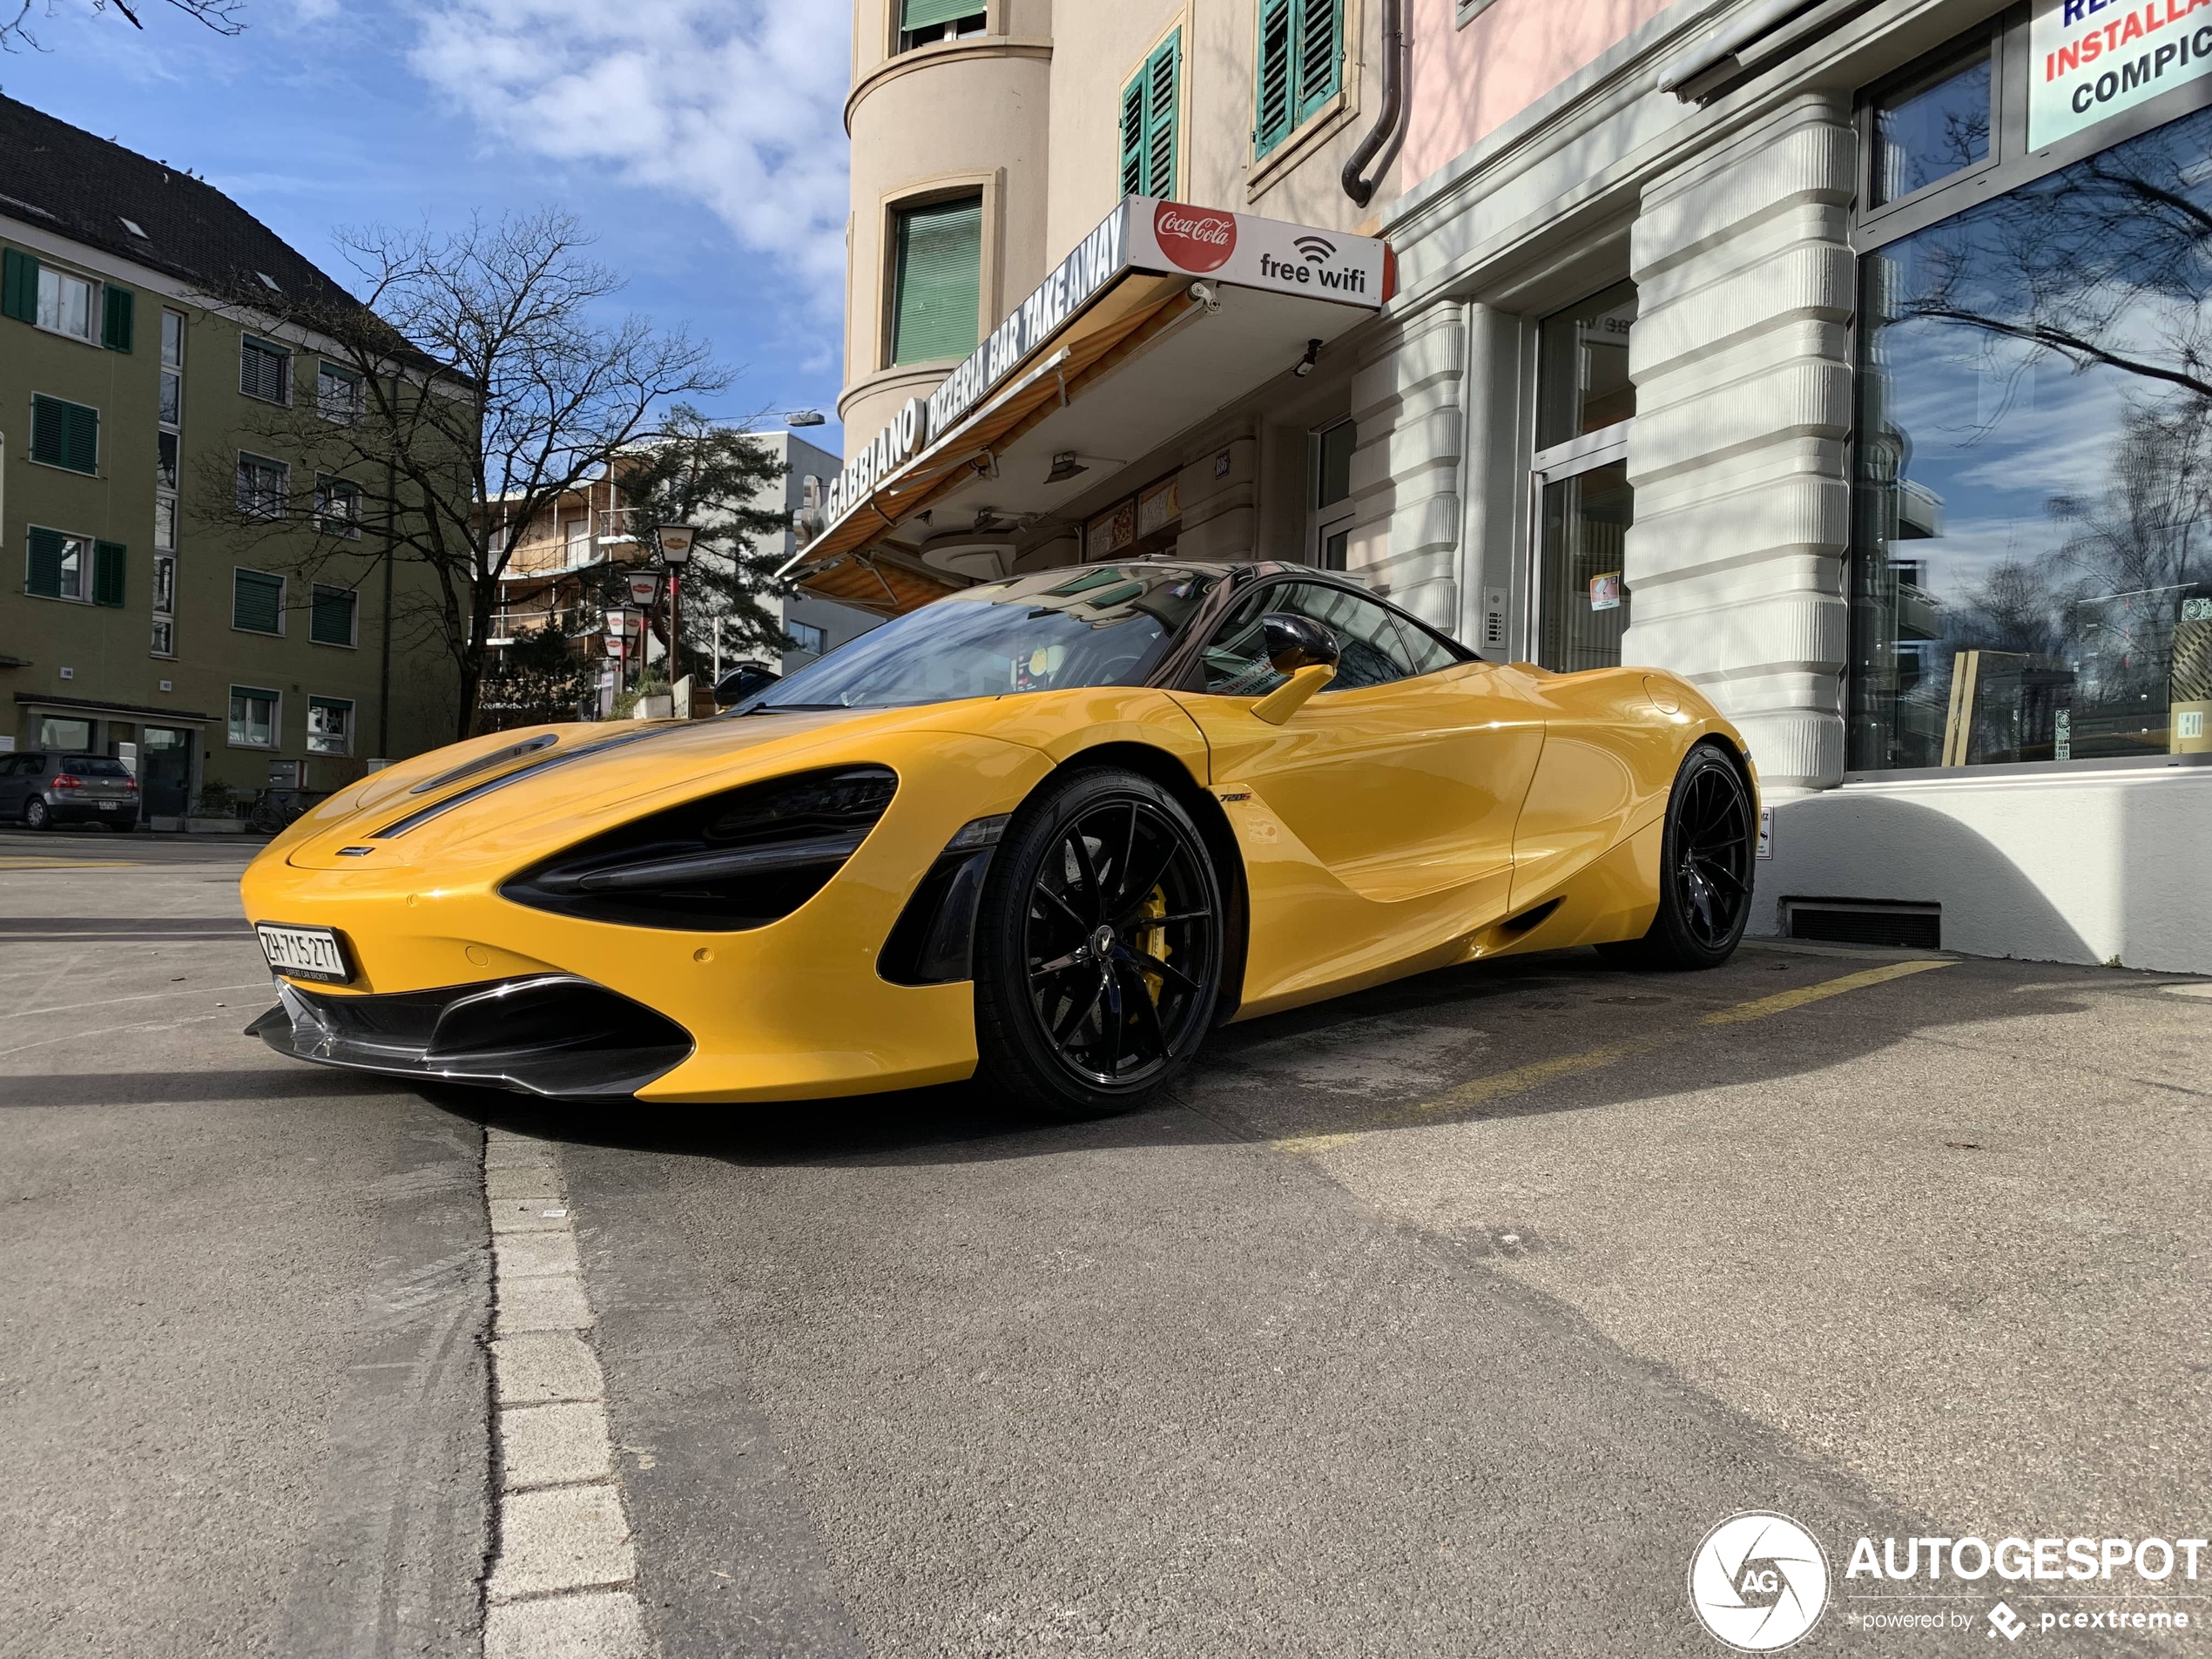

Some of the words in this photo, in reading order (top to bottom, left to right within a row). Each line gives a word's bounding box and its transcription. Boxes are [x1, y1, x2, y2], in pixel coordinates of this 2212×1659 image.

[2072, 25, 2212, 113] COMPIC
[1157, 211, 1233, 246] Coca-Cola
[1260, 253, 1310, 283] free
[1318, 266, 1366, 293] wifi
[828, 397, 916, 523] GABBIANO
[929, 346, 984, 441] PIZZERIA
[988, 310, 1020, 386] BAR
[1220, 792, 1251, 802] 720S
